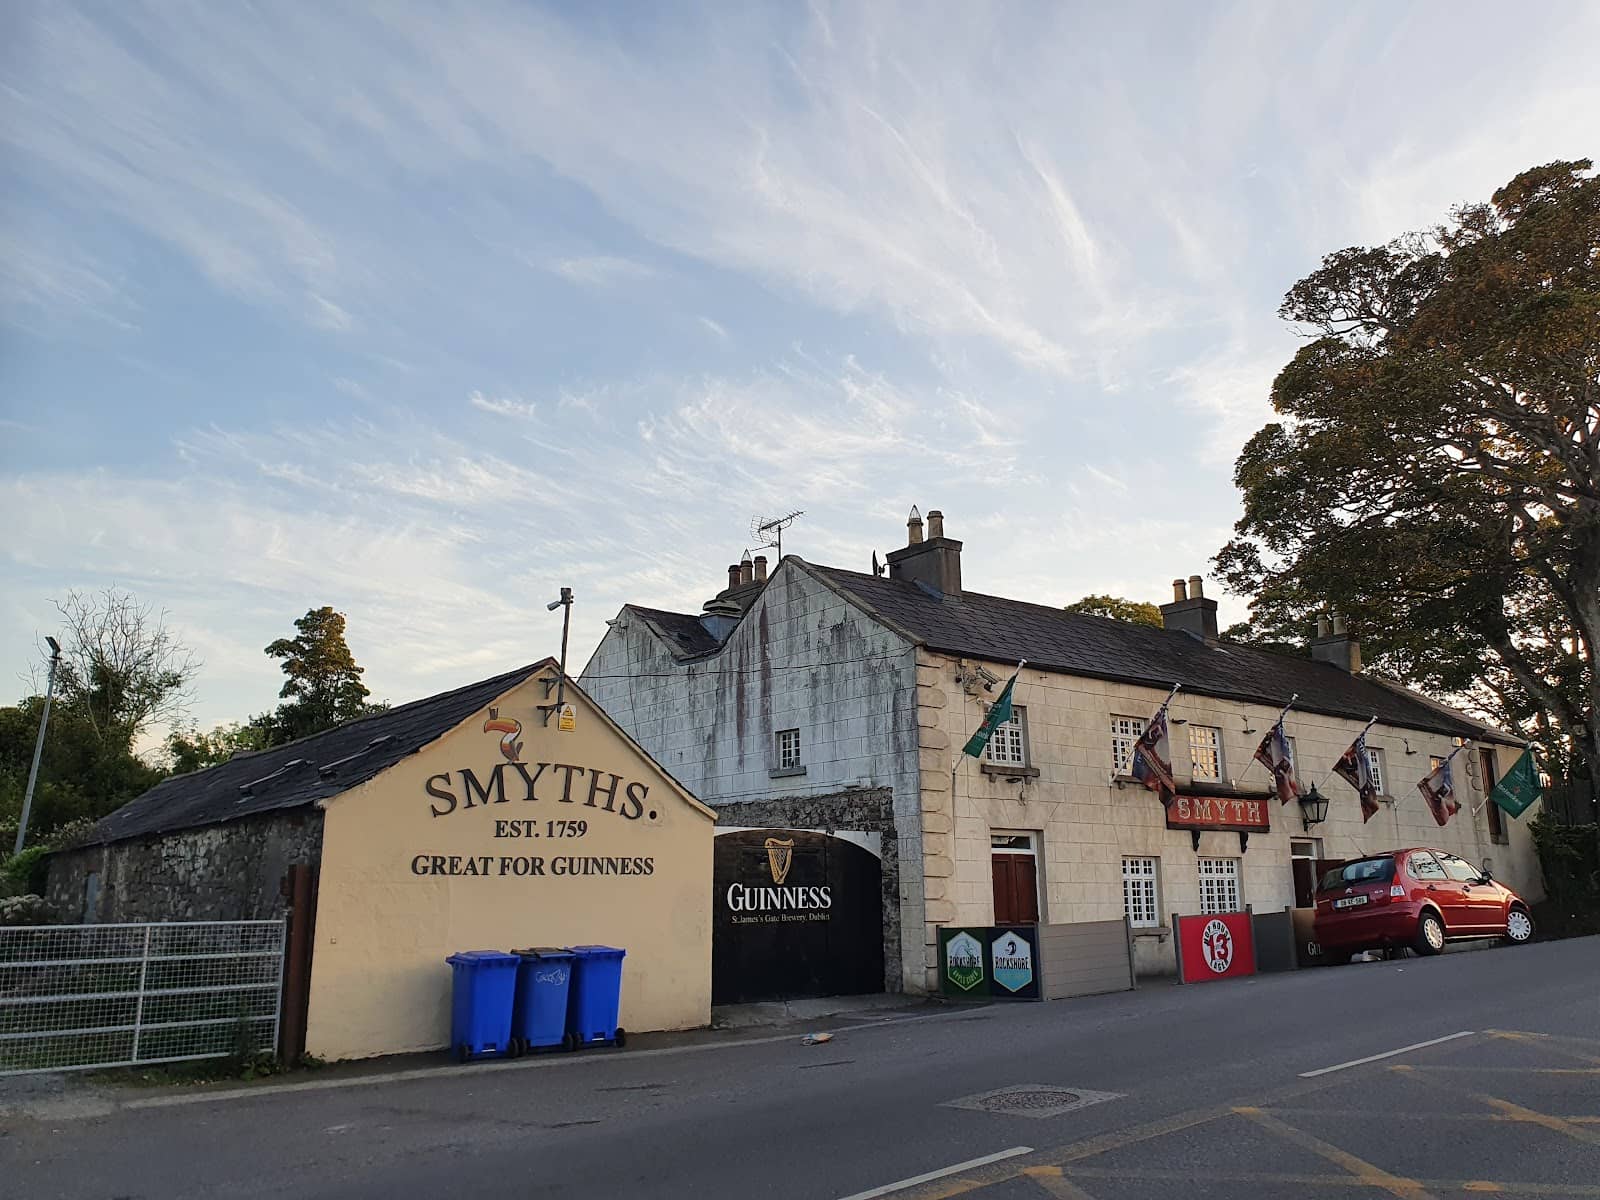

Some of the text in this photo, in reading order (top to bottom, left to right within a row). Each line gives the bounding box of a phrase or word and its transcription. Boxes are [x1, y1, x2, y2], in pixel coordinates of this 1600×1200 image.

[425, 762, 657, 820] SMYTHS.
[1177, 798, 1261, 823] SMYTH
[494, 820, 587, 838] EST. 1759
[411, 855, 654, 876] GREAT FOR GUINNESS
[727, 883, 832, 911] GUINNESS
[1208, 933, 1229, 961] 13
[995, 956, 1030, 969] ROCKSHORE
